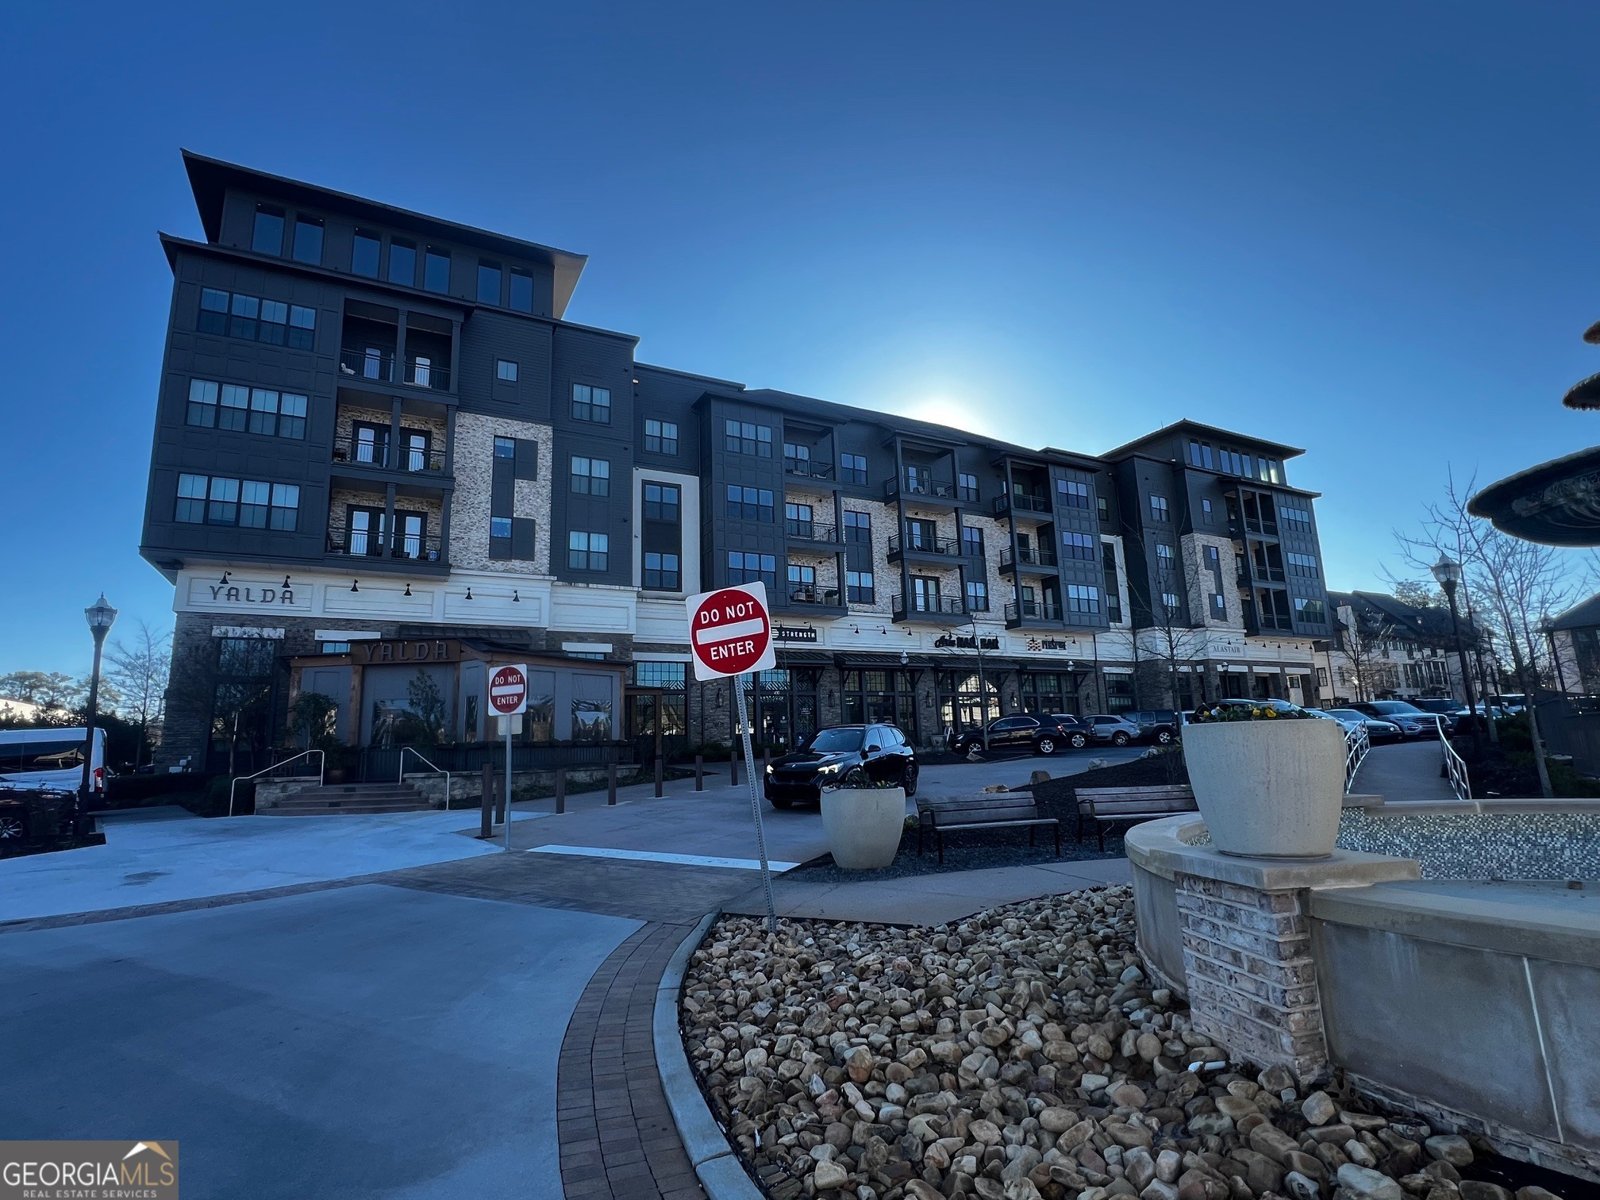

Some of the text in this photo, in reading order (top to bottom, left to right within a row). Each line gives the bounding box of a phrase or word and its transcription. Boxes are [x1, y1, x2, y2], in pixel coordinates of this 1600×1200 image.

[209, 585, 295, 604] YALDA
[700, 601, 754, 624] DO NOT
[362, 641, 449, 661] YALDA
[710, 640, 755, 660] ENTER
[495, 674, 522, 685] DO NOT
[496, 696, 518, 706] ENTER
